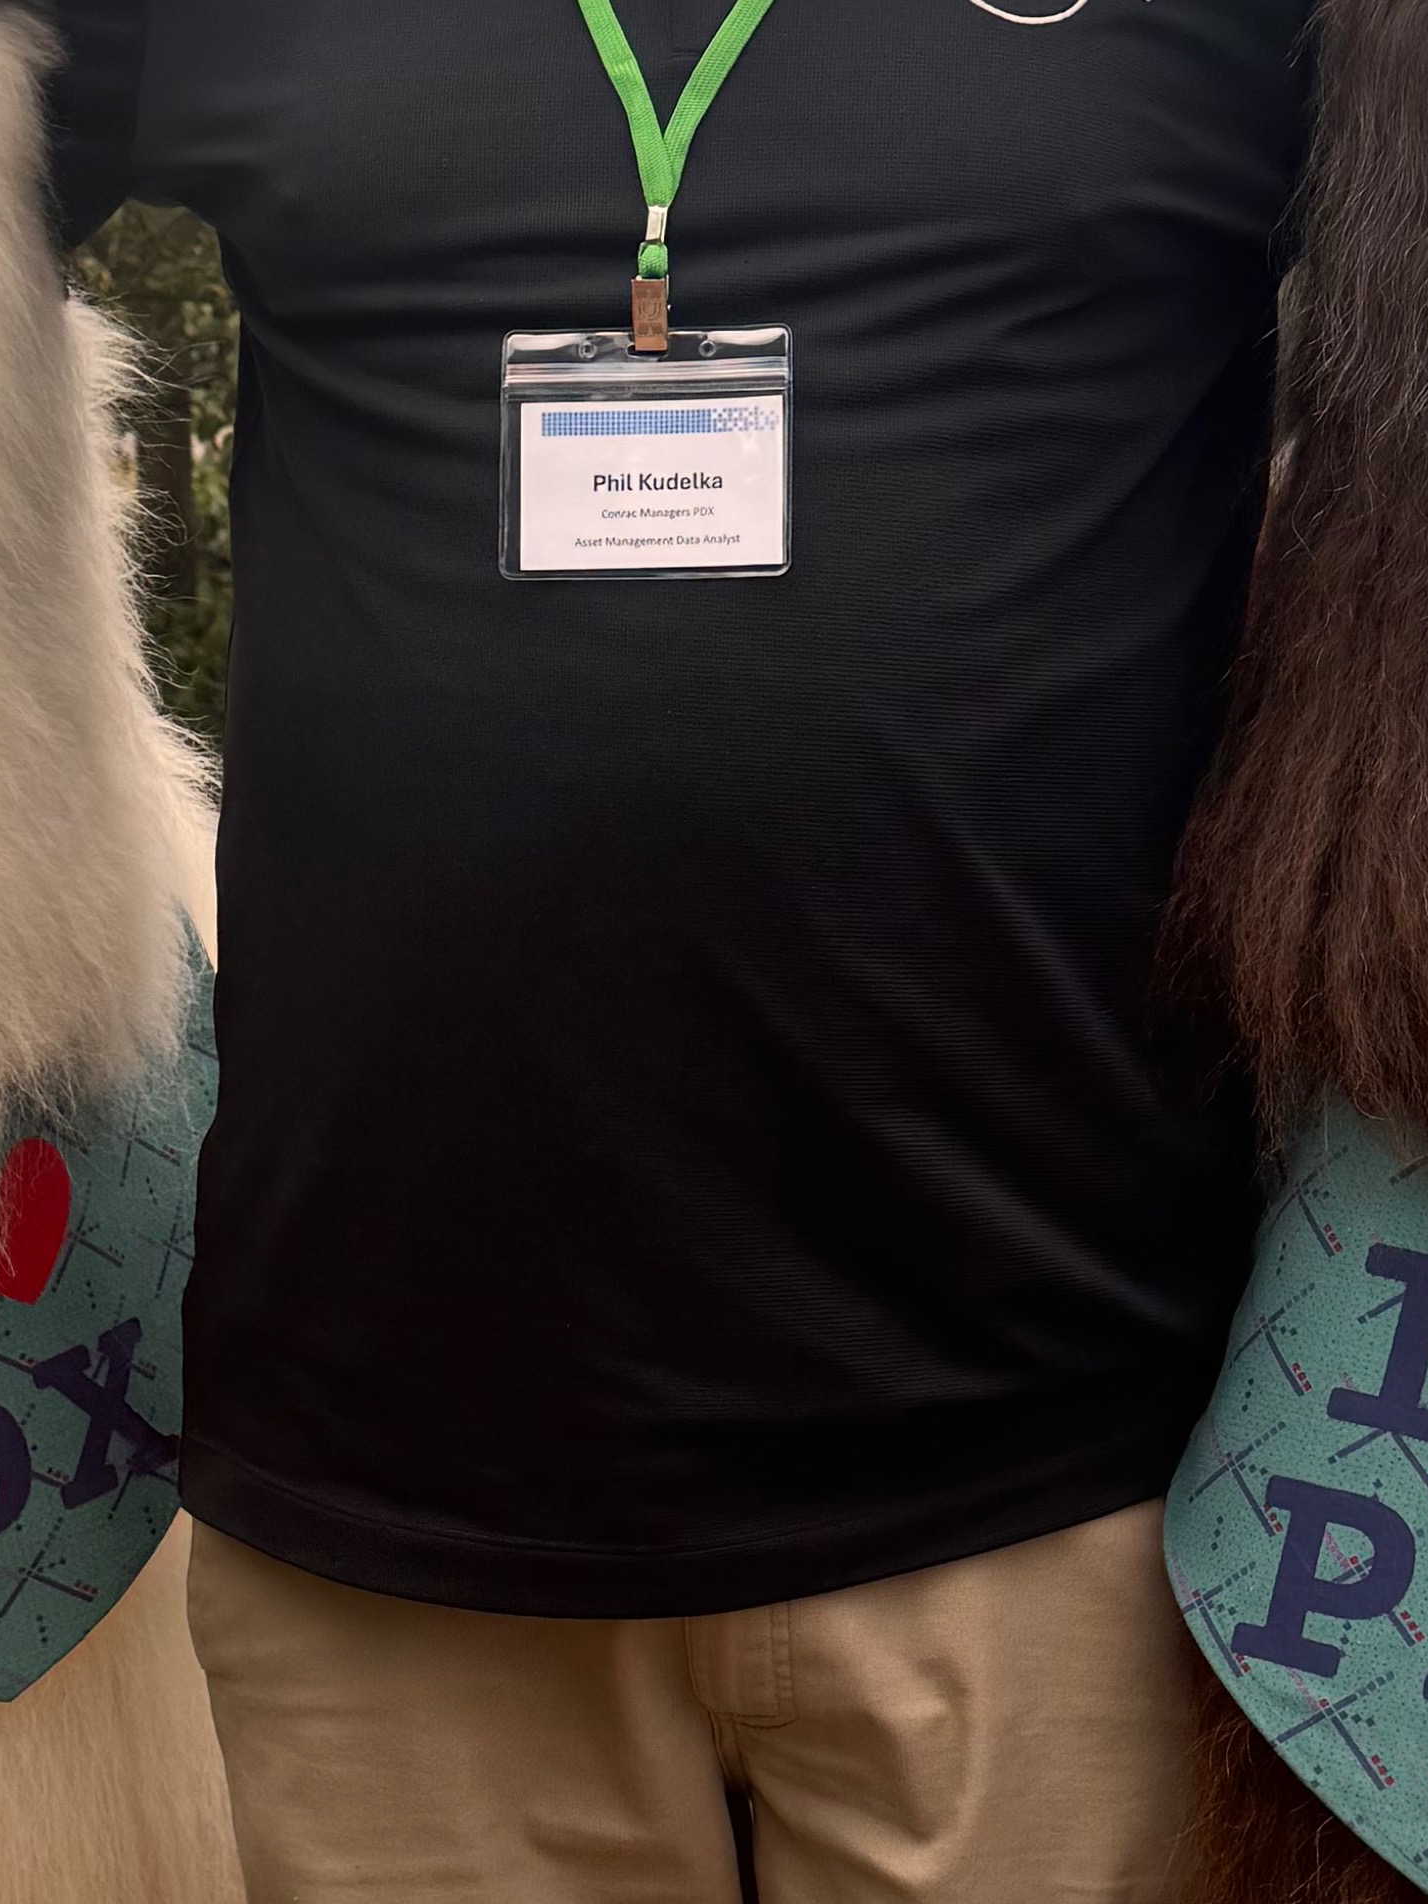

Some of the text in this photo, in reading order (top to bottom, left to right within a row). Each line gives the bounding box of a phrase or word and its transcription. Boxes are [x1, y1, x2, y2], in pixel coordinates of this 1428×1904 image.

[593, 472, 723, 492] Phil Kudelka
[601, 506, 715, 520] Conrac Managers PDX
[574, 533, 741, 548] Asset Management Data Analyst
